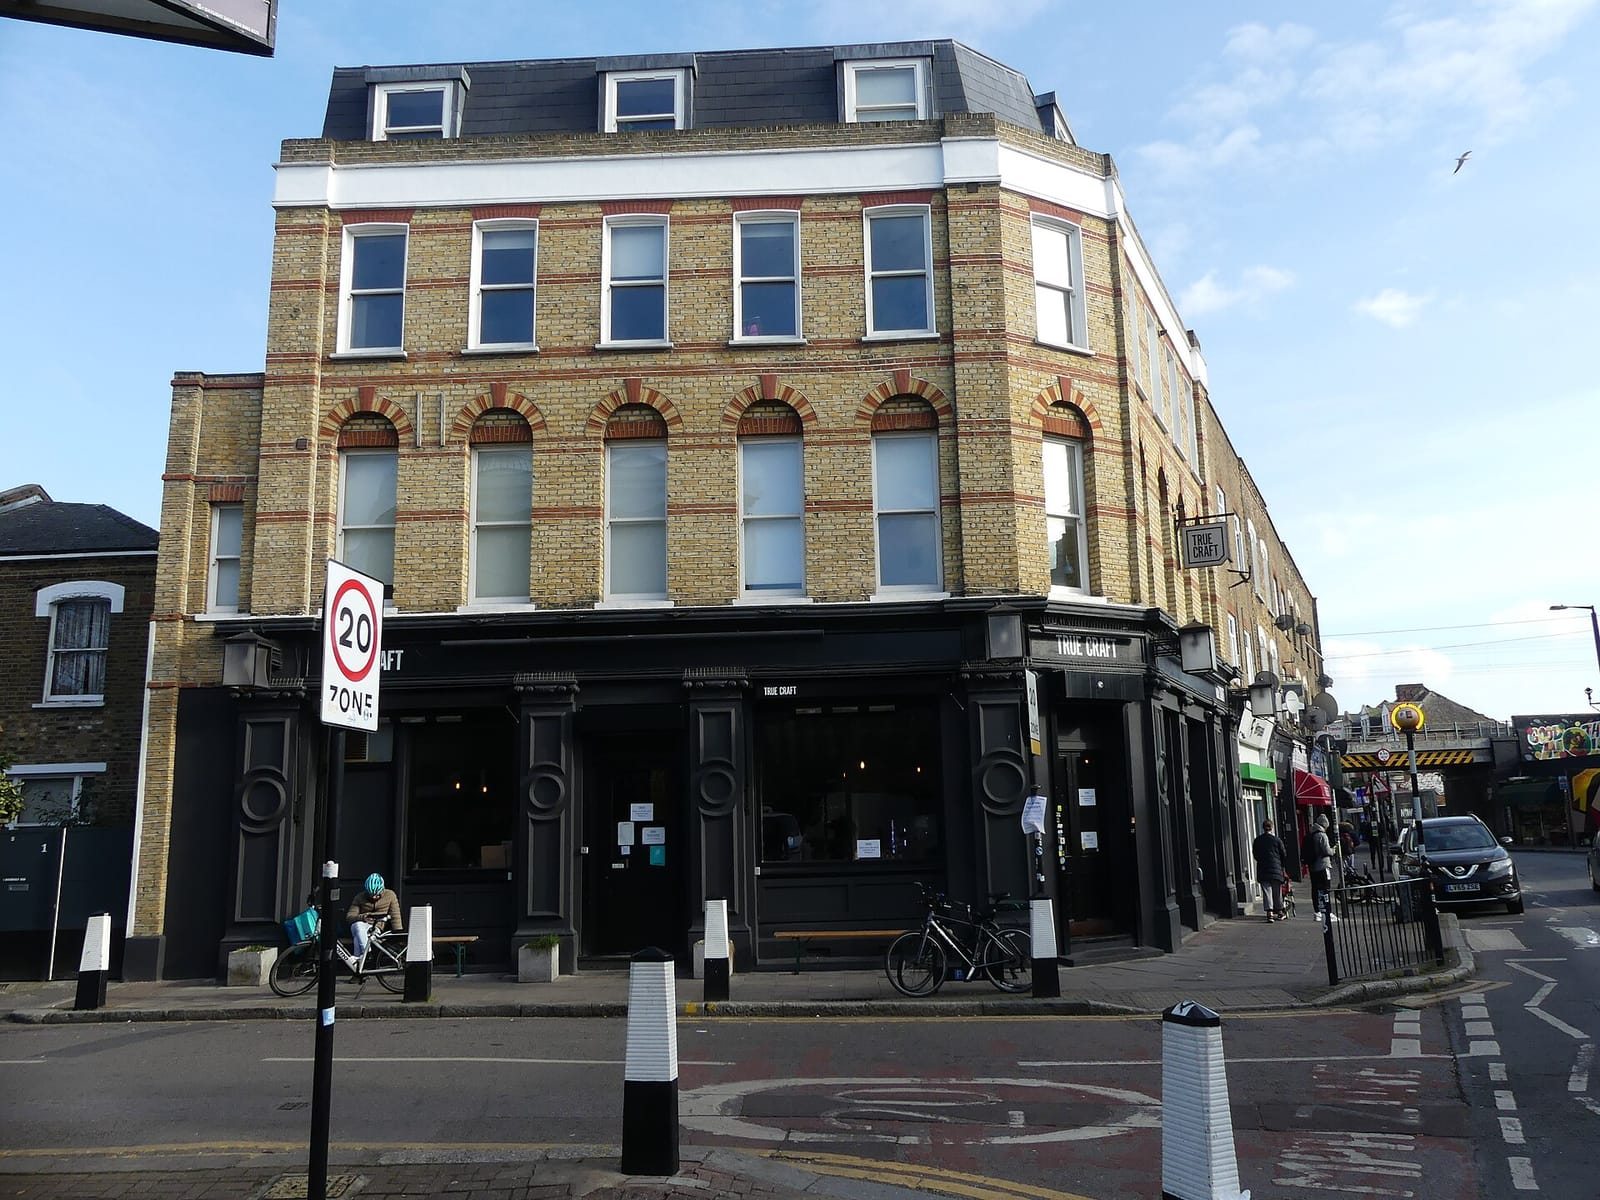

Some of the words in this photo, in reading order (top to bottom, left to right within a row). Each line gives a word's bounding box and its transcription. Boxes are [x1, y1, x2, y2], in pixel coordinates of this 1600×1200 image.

[1192, 533, 1213, 546] TRUE
[1193, 544, 1218, 558] CRAFT
[339, 607, 371, 653] 20
[1056, 634, 1083, 656] TRUE
[1085, 637, 1117, 658] CRAFT
[380, 650, 404, 671] AFT
[763, 686, 778, 696] TRUE
[779, 686, 797, 696] CRAFT
